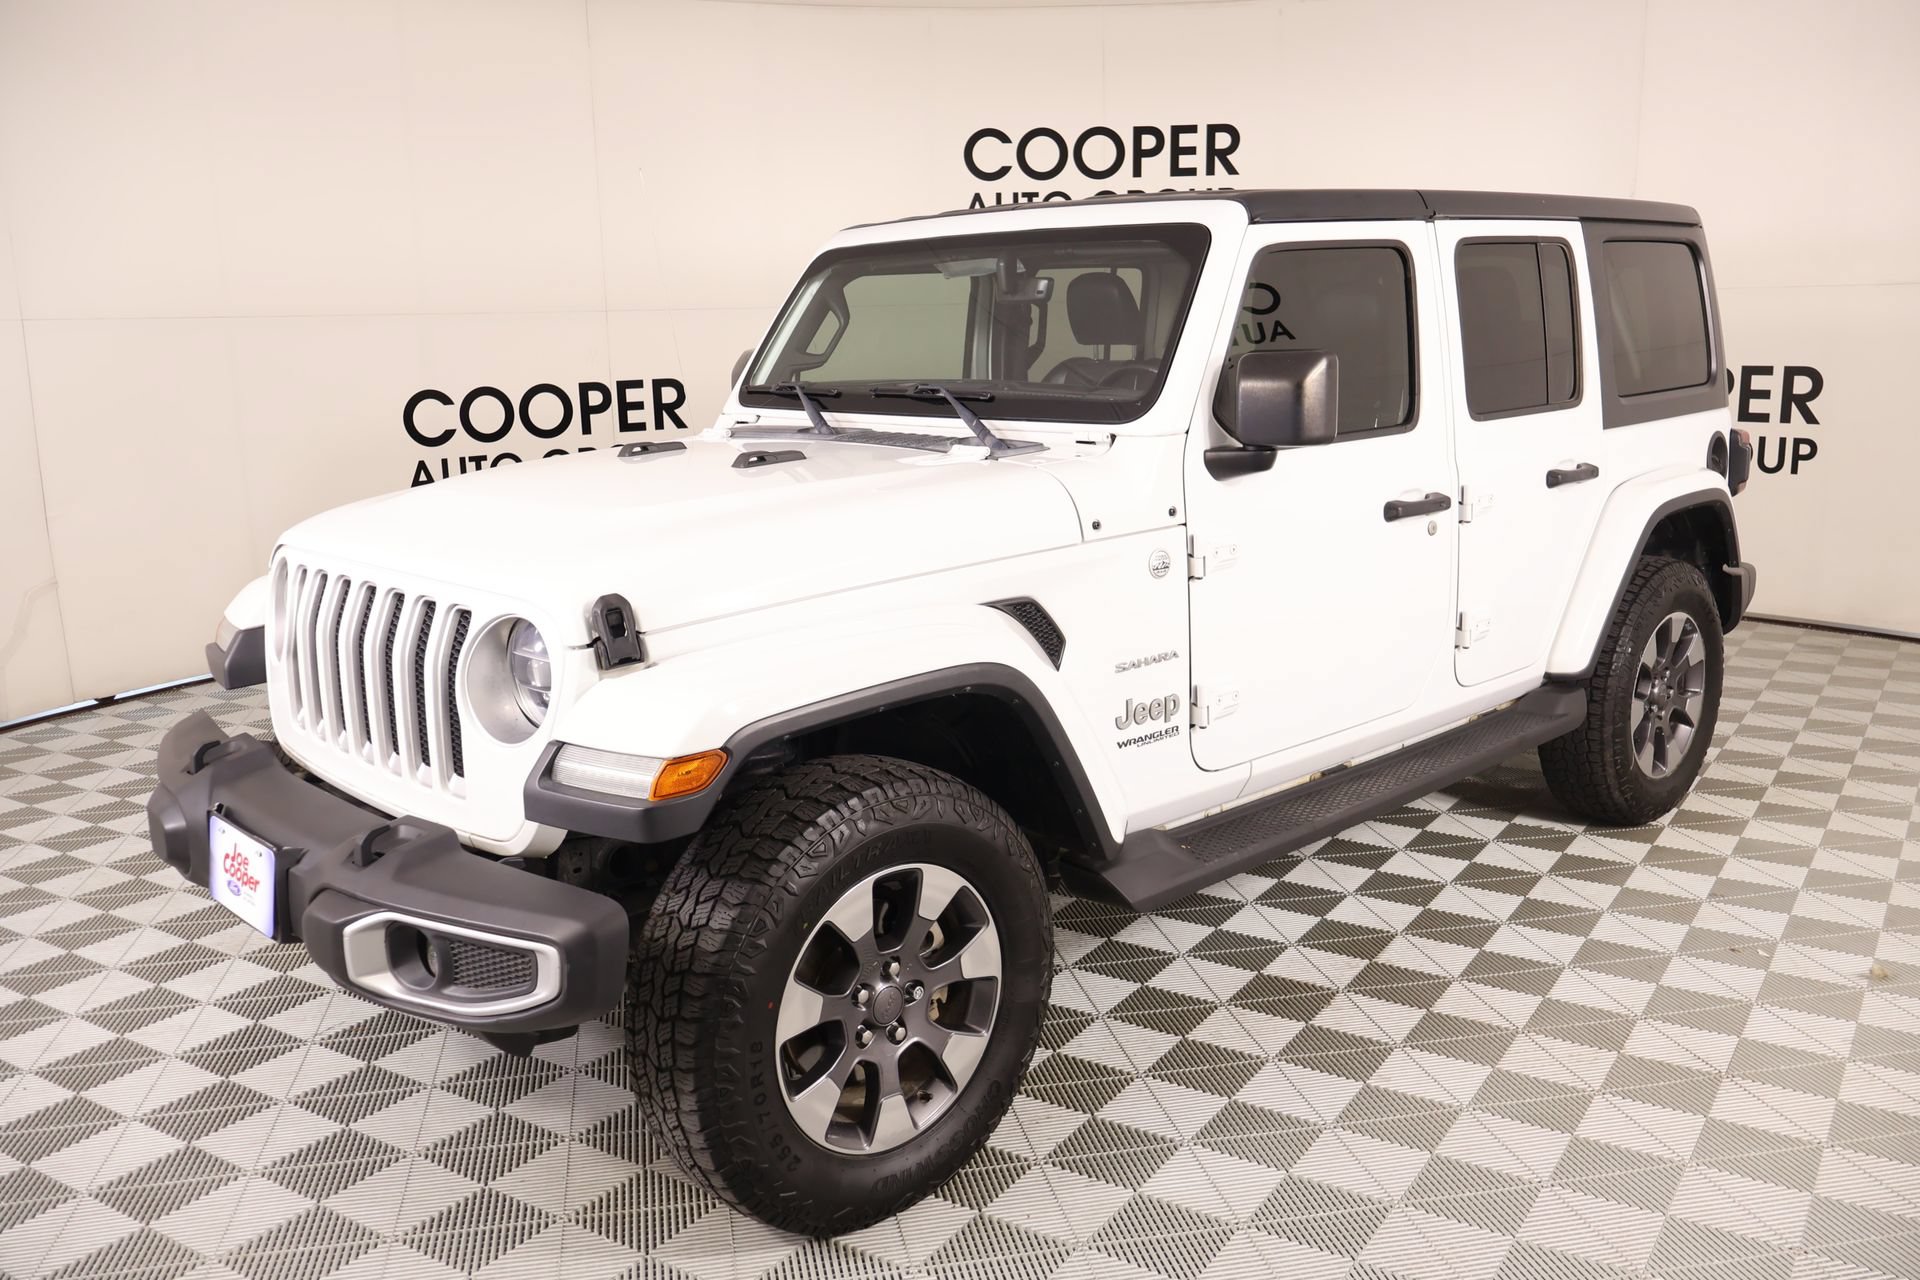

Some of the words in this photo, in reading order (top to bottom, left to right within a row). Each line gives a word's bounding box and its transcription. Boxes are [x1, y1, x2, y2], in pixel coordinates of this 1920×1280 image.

[963, 123, 1241, 181] COOPER
[403, 378, 688, 447] COOPER
[1727, 365, 1824, 425] ER
[1749, 436, 1818, 475] UP
[1115, 650, 1179, 673] SAHARA
[1115, 693, 1180, 730] Jeep
[1117, 725, 1179, 749] WRANGLER
[1136, 731, 1180, 748] UNLIMITED
[223, 852, 260, 893] Cooper
[230, 842, 250, 872] Joe
